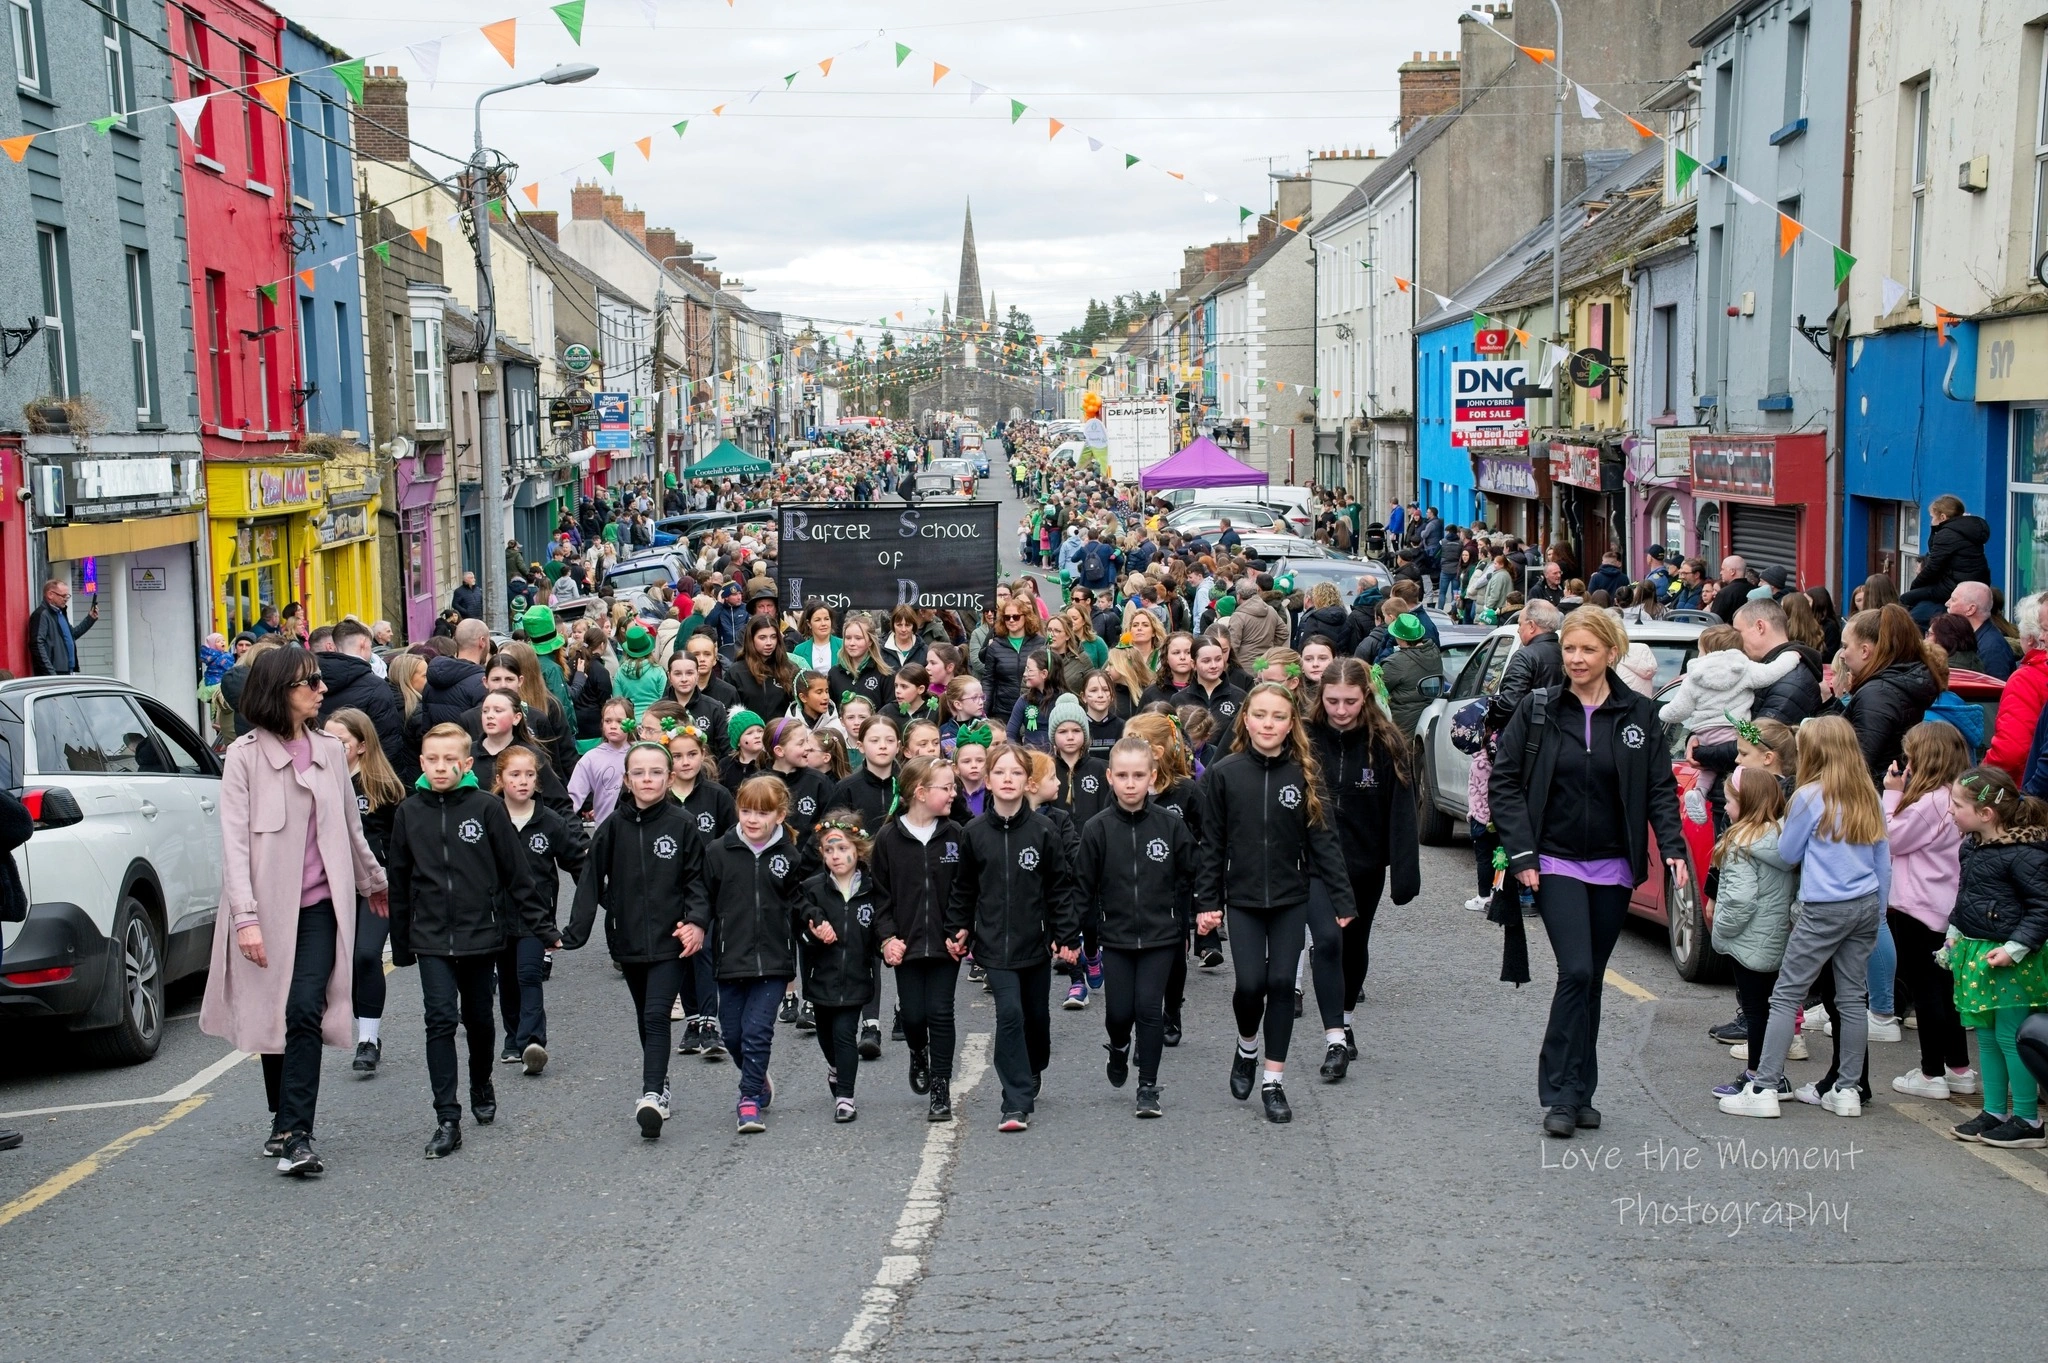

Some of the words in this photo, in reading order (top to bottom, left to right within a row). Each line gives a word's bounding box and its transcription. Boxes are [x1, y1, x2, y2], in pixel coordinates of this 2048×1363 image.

[1458, 367, 1526, 393] DNG
[1108, 407, 1167, 416] DEMPSEY
[1469, 410, 1487, 419] FOR
[1489, 409, 1511, 418] SALE
[1456, 431, 1463, 439] 4
[1464, 431, 1483, 439] Two
[1484, 430, 1502, 438] Bed
[1503, 430, 1524, 439] Apts
[1471, 438, 1497, 447] Retail
[1498, 438, 1518, 446] Unit
[695, 467, 723, 476] Cootehill
[724, 465, 742, 473] Celtic
[743, 464, 760, 472] GAA
[284, 467, 308, 503] MAX
[899, 510, 980, 539] School
[878, 551, 904, 569] of
[897, 578, 985, 611] Dancing
